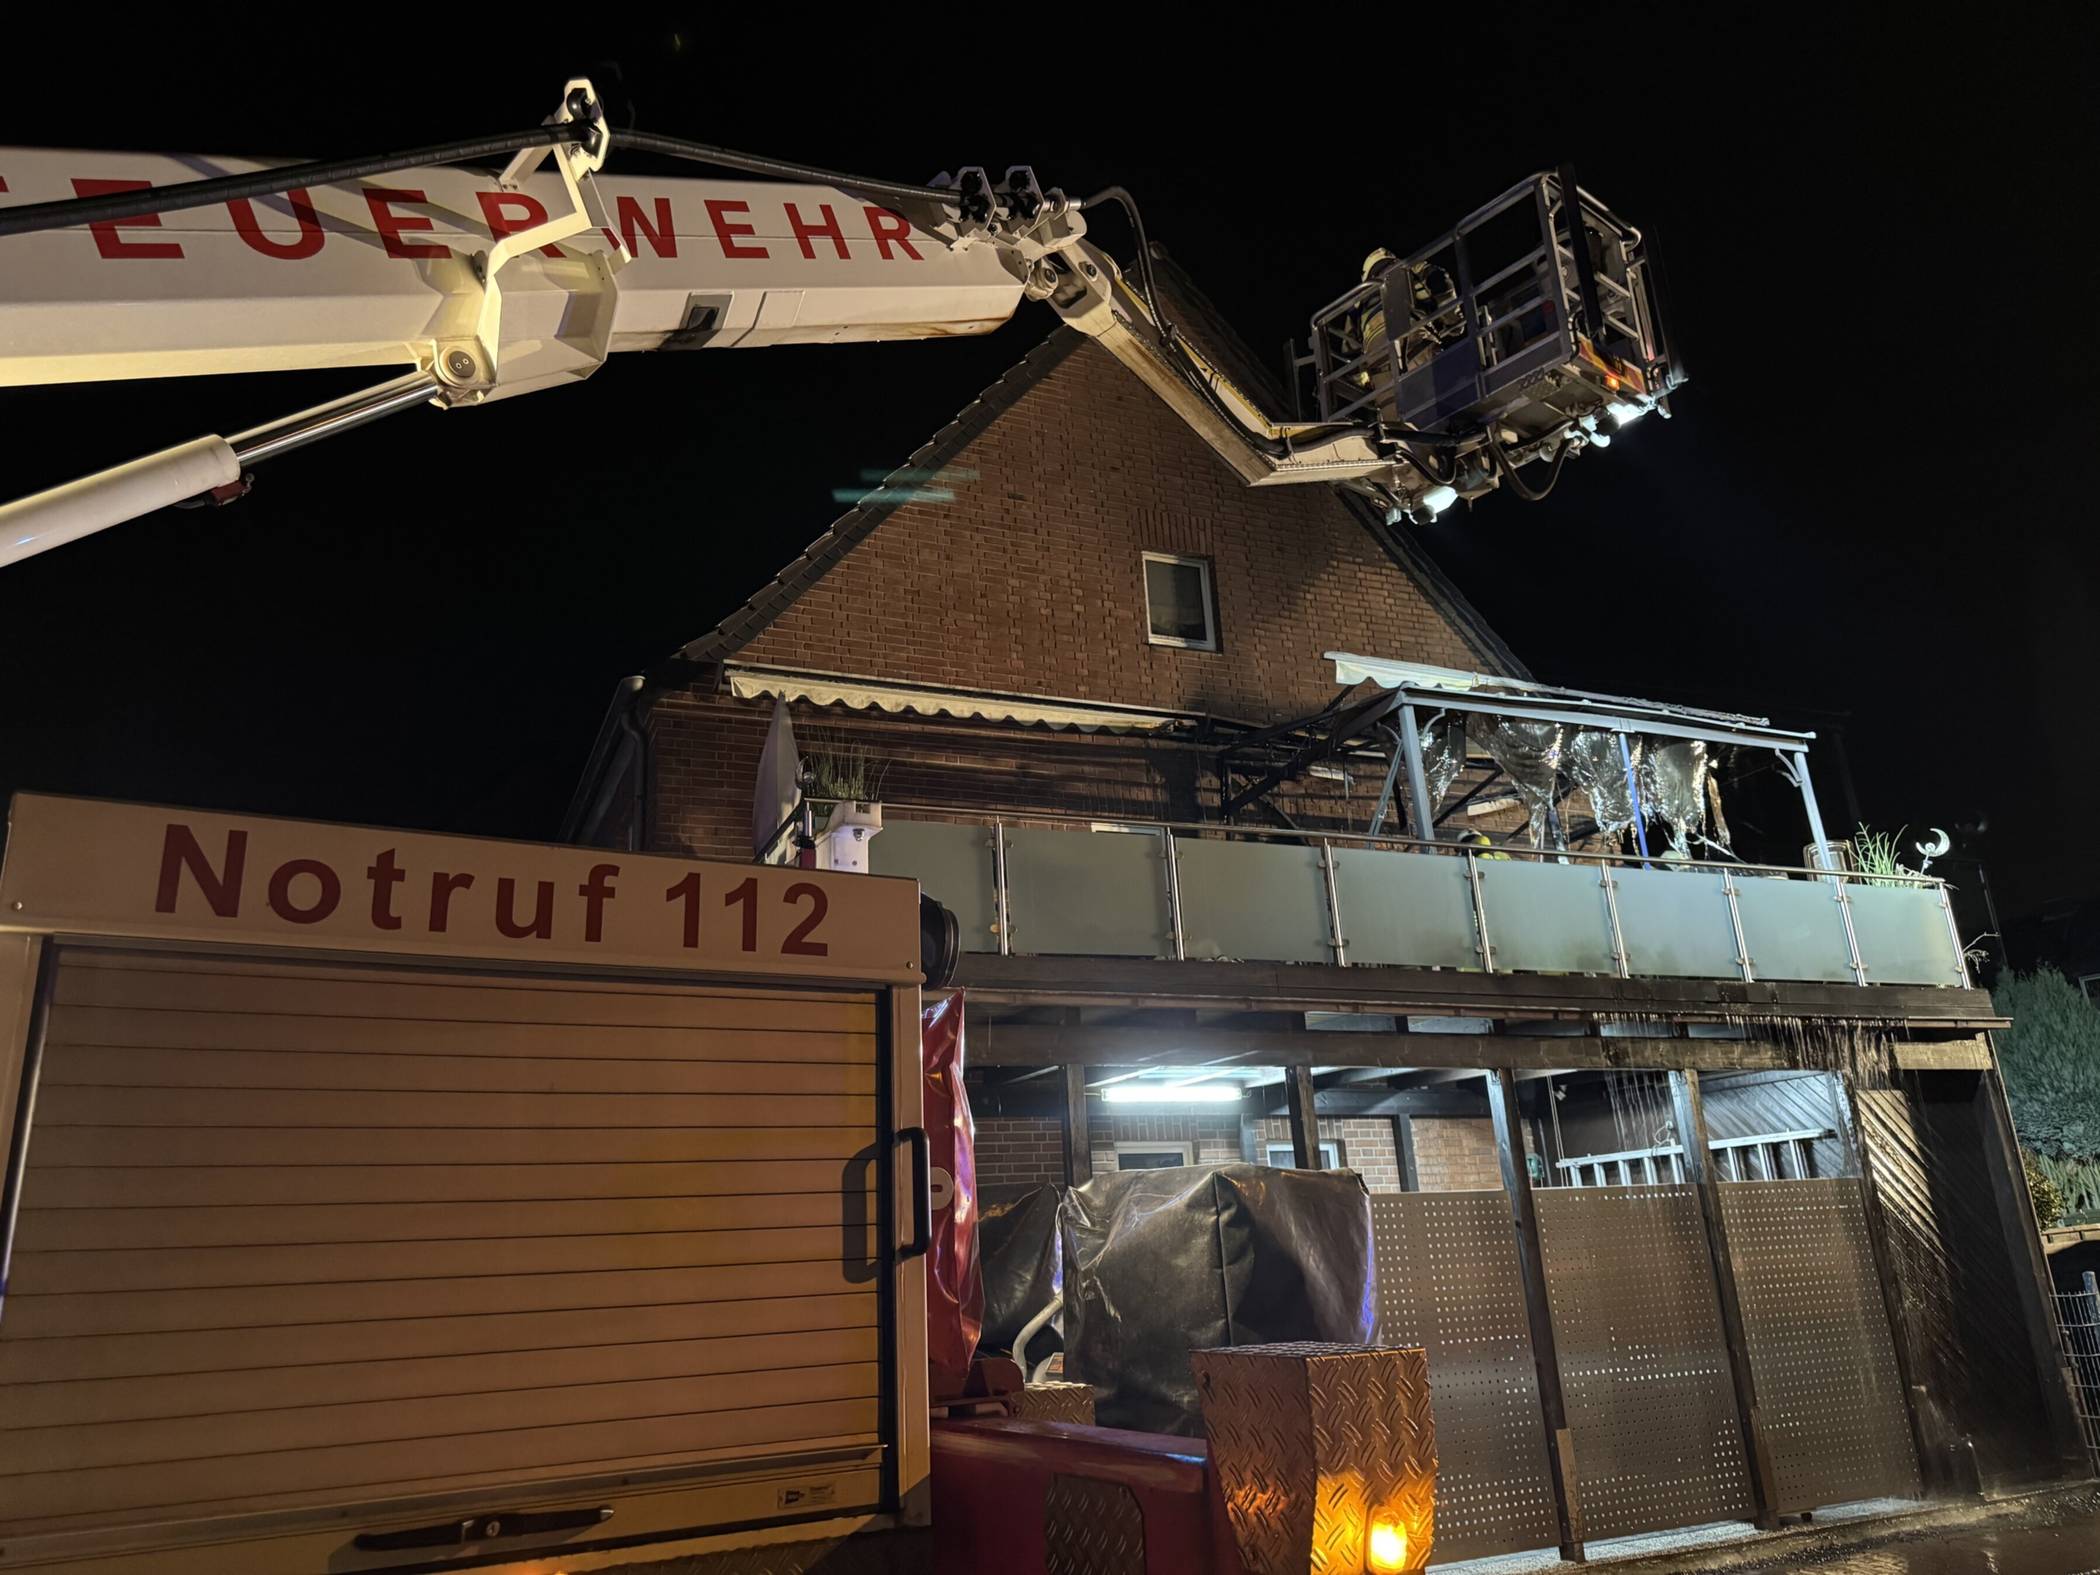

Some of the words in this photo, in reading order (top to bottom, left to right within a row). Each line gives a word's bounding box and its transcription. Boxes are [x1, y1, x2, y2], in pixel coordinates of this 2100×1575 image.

[0, 175, 925, 261] EUERWEHR
[154, 823, 621, 943] Notruf
[665, 872, 831, 957] 112
